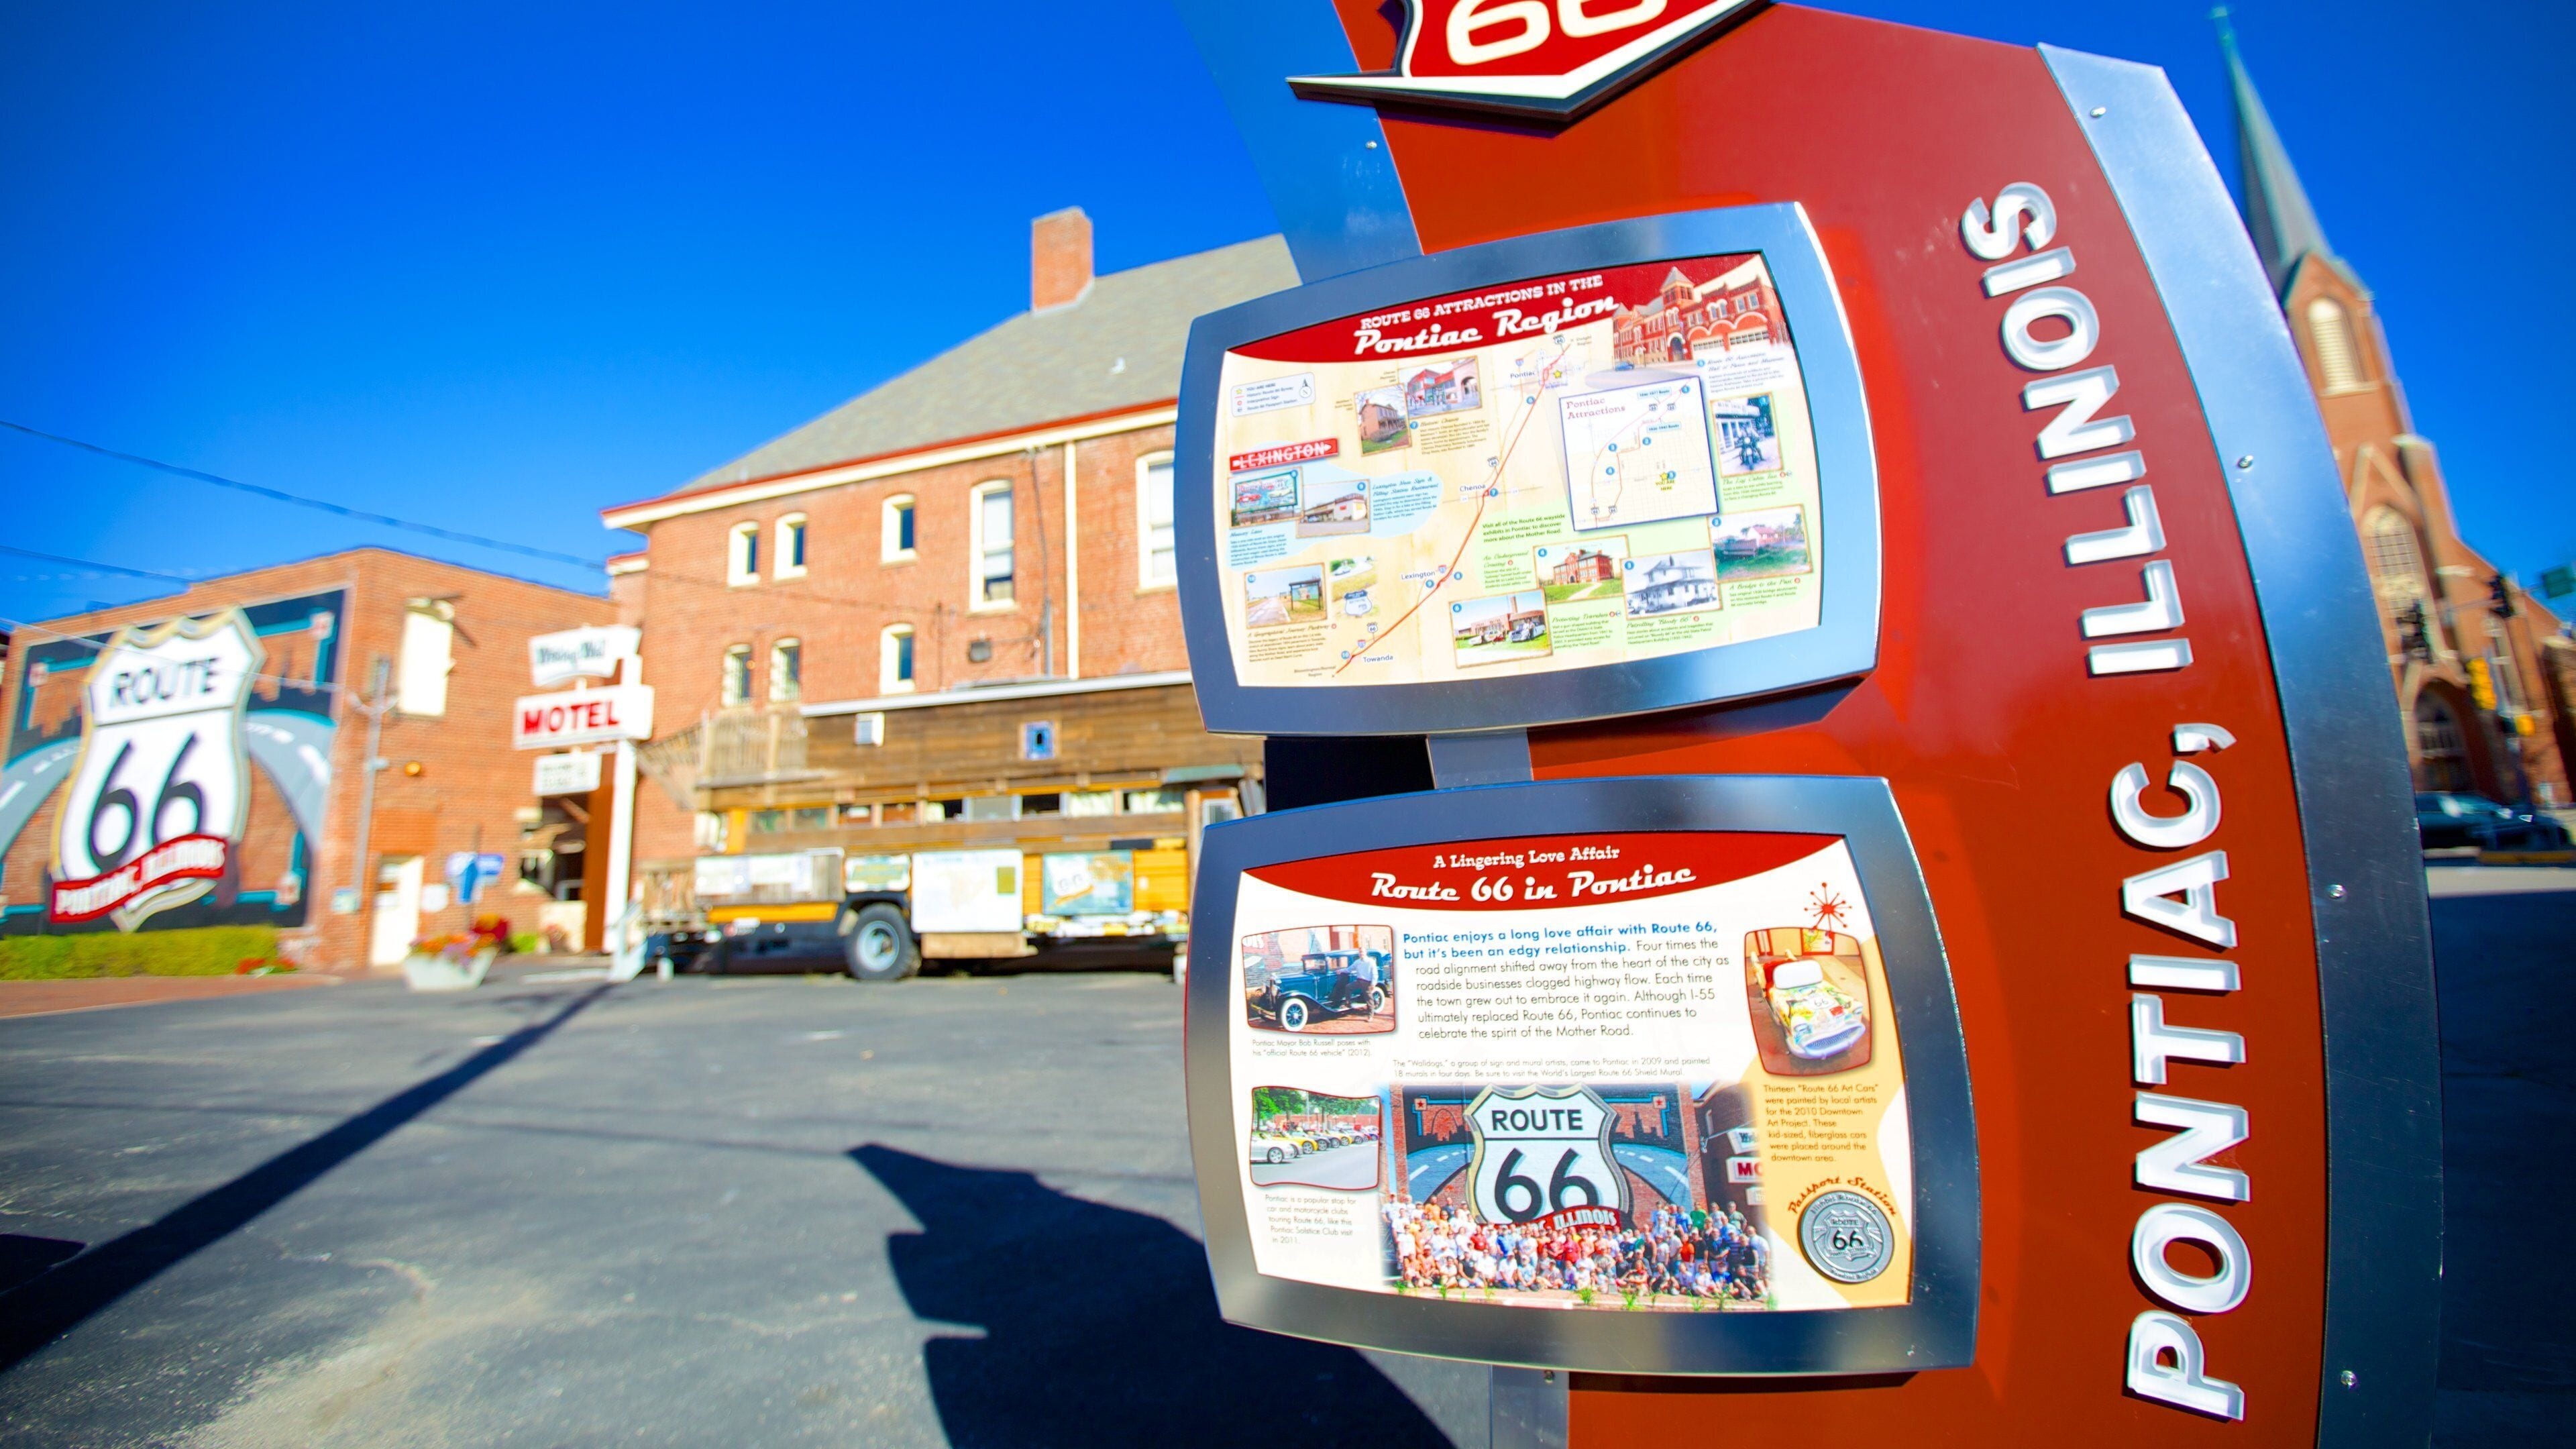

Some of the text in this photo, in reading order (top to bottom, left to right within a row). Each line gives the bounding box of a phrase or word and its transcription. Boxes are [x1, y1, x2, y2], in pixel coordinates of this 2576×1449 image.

[1446, 0, 1669, 66] 66
[1360, 274, 1603, 330] ROUTE 66 ATTRACTIONS IN THE
[1353, 295, 1620, 355] Pontiac Region
[1566, 398, 1605, 409] Pontiac
[1568, 406, 1625, 419] Attractions
[1240, 441, 1326, 469] LEXINGTON
[1401, 571, 1435, 580] Lexington
[111, 657, 219, 706] ROUTE
[523, 700, 619, 735] MOTEL
[88, 731, 207, 872] 66
[1962, 181, 2253, 1421] PONTIAC, ILLINOIS
[1433, 846, 1620, 870] A Lingering Love Affair
[1371, 864, 1697, 902] Route 66 in Pontiac
[1403, 933, 1448, 943] Pontiac
[1453, 931, 1493, 943] enjoys
[1511, 929, 1540, 941] long
[1544, 928, 1571, 938] love
[1576, 925, 1613, 936] affair
[1617, 924, 1646, 934] with
[1652, 923, 1690, 933] Route
[1695, 921, 1717, 932] 66,
[1403, 949, 1424, 959] but
[1428, 948, 1446, 957] it's
[1451, 947, 1483, 957] been
[1508, 945, 1540, 957] edgy
[1545, 942, 1630, 953] relationship.
[1636, 940, 1662, 951] Four
[1666, 941, 1696, 949] times
[1700, 938, 1717, 948] the
[1415, 963, 1440, 974] road
[1444, 963, 1497, 976] alignment
[1500, 961, 1535, 972] shifted
[1539, 963, 1567, 973] away
[1570, 959, 1597, 969] from
[1601, 957, 1618, 969] the
[1622, 957, 1652, 968] heart
[1656, 955, 1666, 967] of
[1670, 955, 1689, 966] the
[1693, 956, 1711, 967] city
[1416, 972, 1713, 990] roadside businesses clogged highway flow. Each time
[1416, 987, 1715, 1008] the town grew out to embrace it again. Although I-55
[1418, 1008, 1697, 1023] ultimately replaced Route 66, Pontiac continues to
[1418, 1024, 1633, 1039] celebrate the spirit of the Mother Road.
[1763, 1084, 1795, 1092] Thirteen
[1827, 1084, 1839, 1092] 66
[1786, 1096, 1817, 1105] painted
[1818, 1095, 1829, 1105] by
[1830, 1095, 1851, 1104] local
[1492, 1109, 1583, 1131] ROUTE
[1766, 1107, 1863, 1115] for the 2010 Downtown
[1780, 1118, 1811, 1127] Project.
[1813, 1118, 1837, 1126] These
[1768, 1130, 1806, 1138] kid-sized,
[1808, 1130, 1847, 1140] fiberglass
[1790, 1142, 1819, 1150] placed
[1821, 1142, 1851, 1150] around
[1852, 1142, 1866, 1150] the
[1494, 1148, 1599, 1222] 66
[1788, 1176, 1896, 1216] Passport Station
[1833, 1228, 1864, 1250] 66
